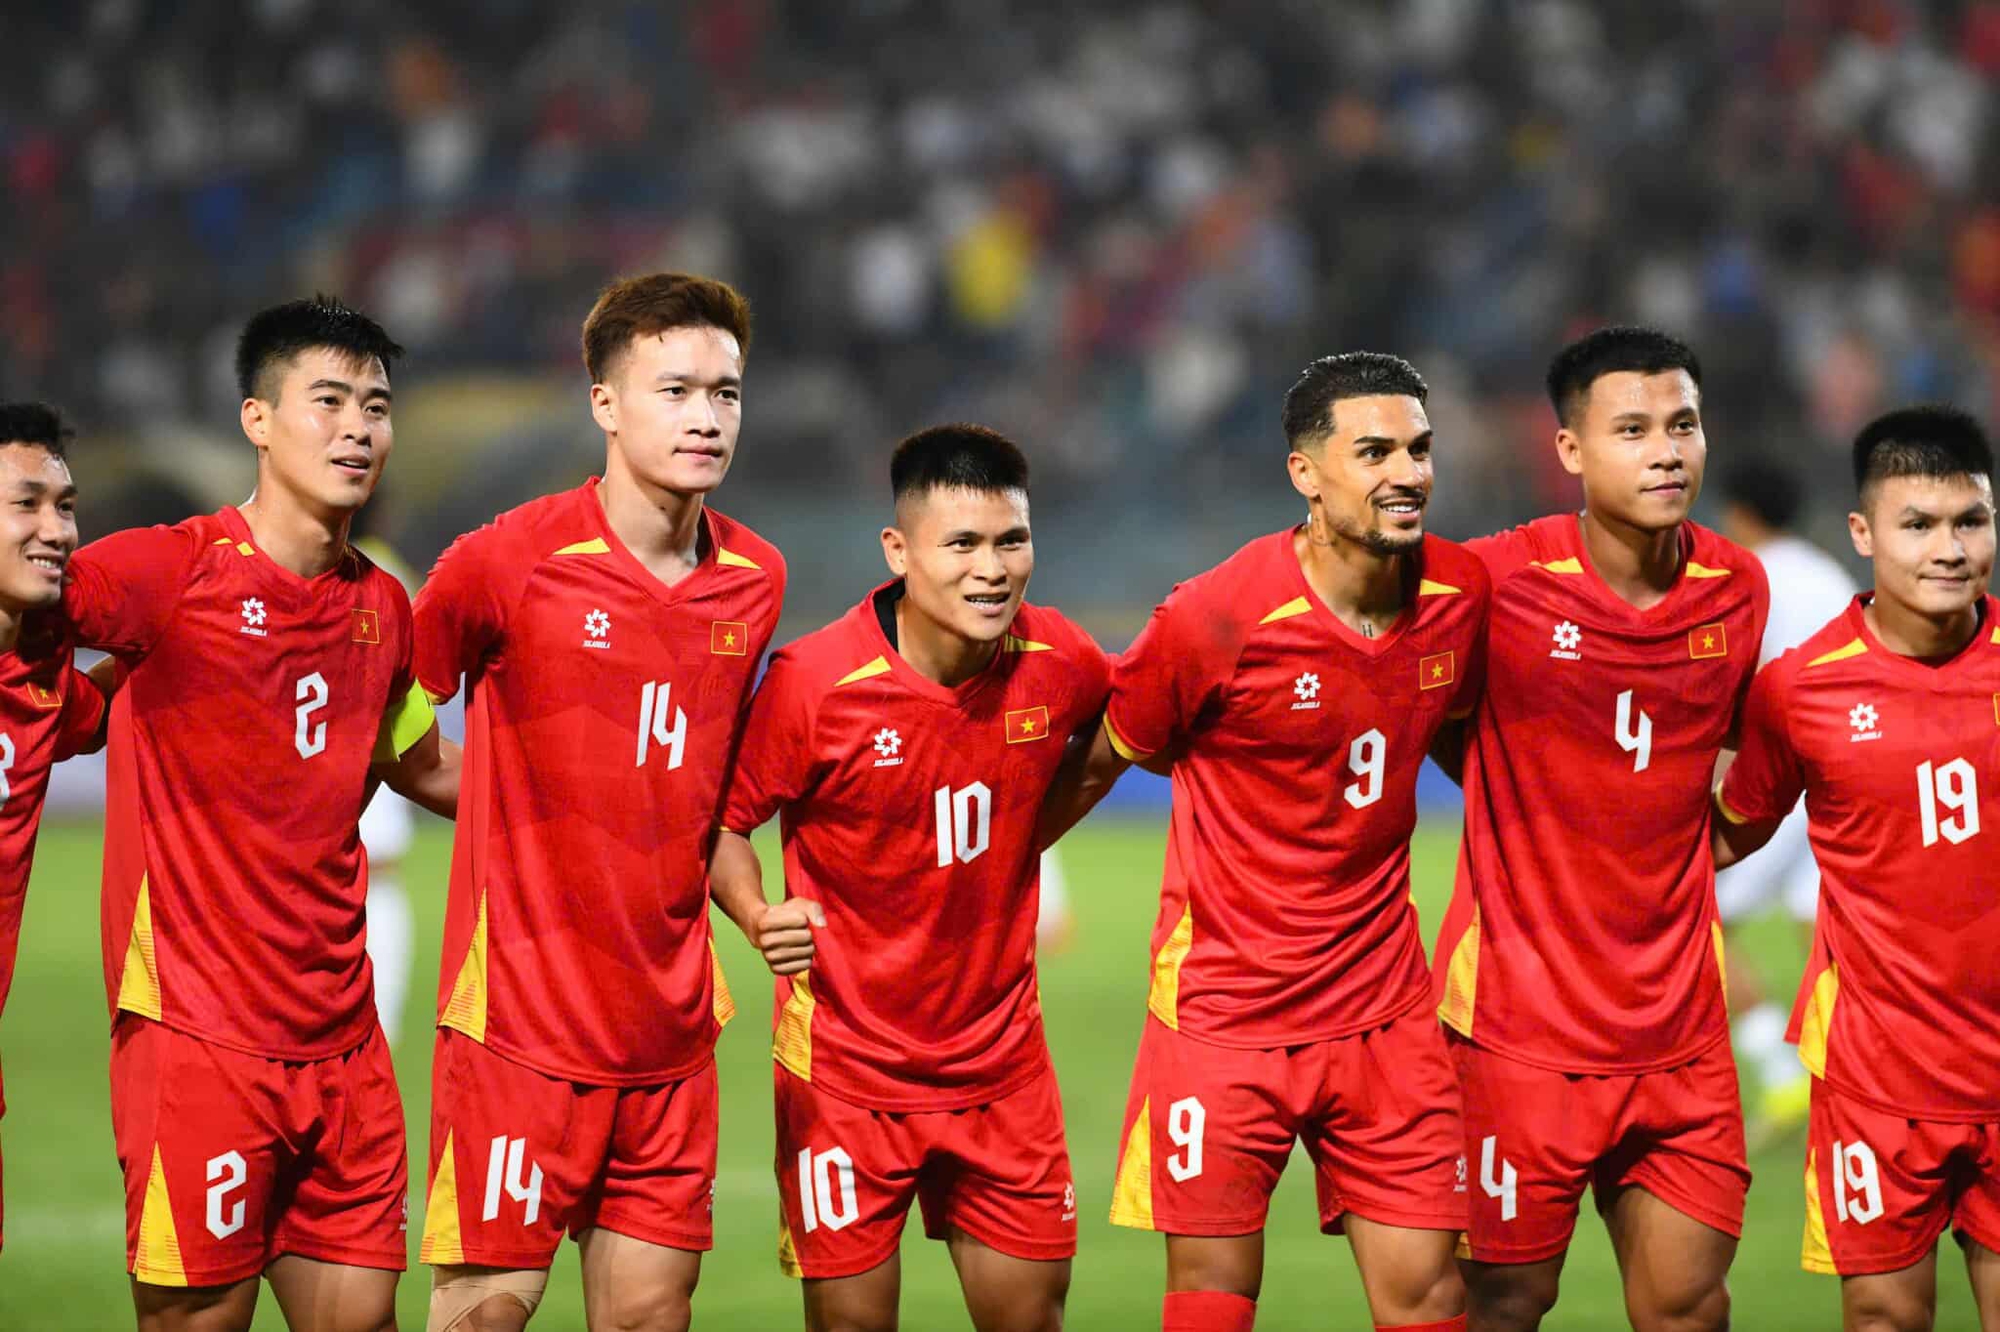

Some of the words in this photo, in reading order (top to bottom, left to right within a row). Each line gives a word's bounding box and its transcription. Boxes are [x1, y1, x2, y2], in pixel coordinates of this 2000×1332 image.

[295, 671, 329, 760] 2
[635, 680, 688, 771] 14
[1614, 689, 1653, 773] 4
[1344, 728, 1386, 809] 9
[1916, 757, 1980, 847] 19
[935, 780, 992, 868] 10
[482, 1135, 544, 1226] 14
[1167, 1096, 1207, 1182] 9
[1480, 1135, 1518, 1222] 4
[1832, 1140, 1885, 1225] 19
[206, 1150, 247, 1240] 2
[798, 1146, 860, 1233] 10
